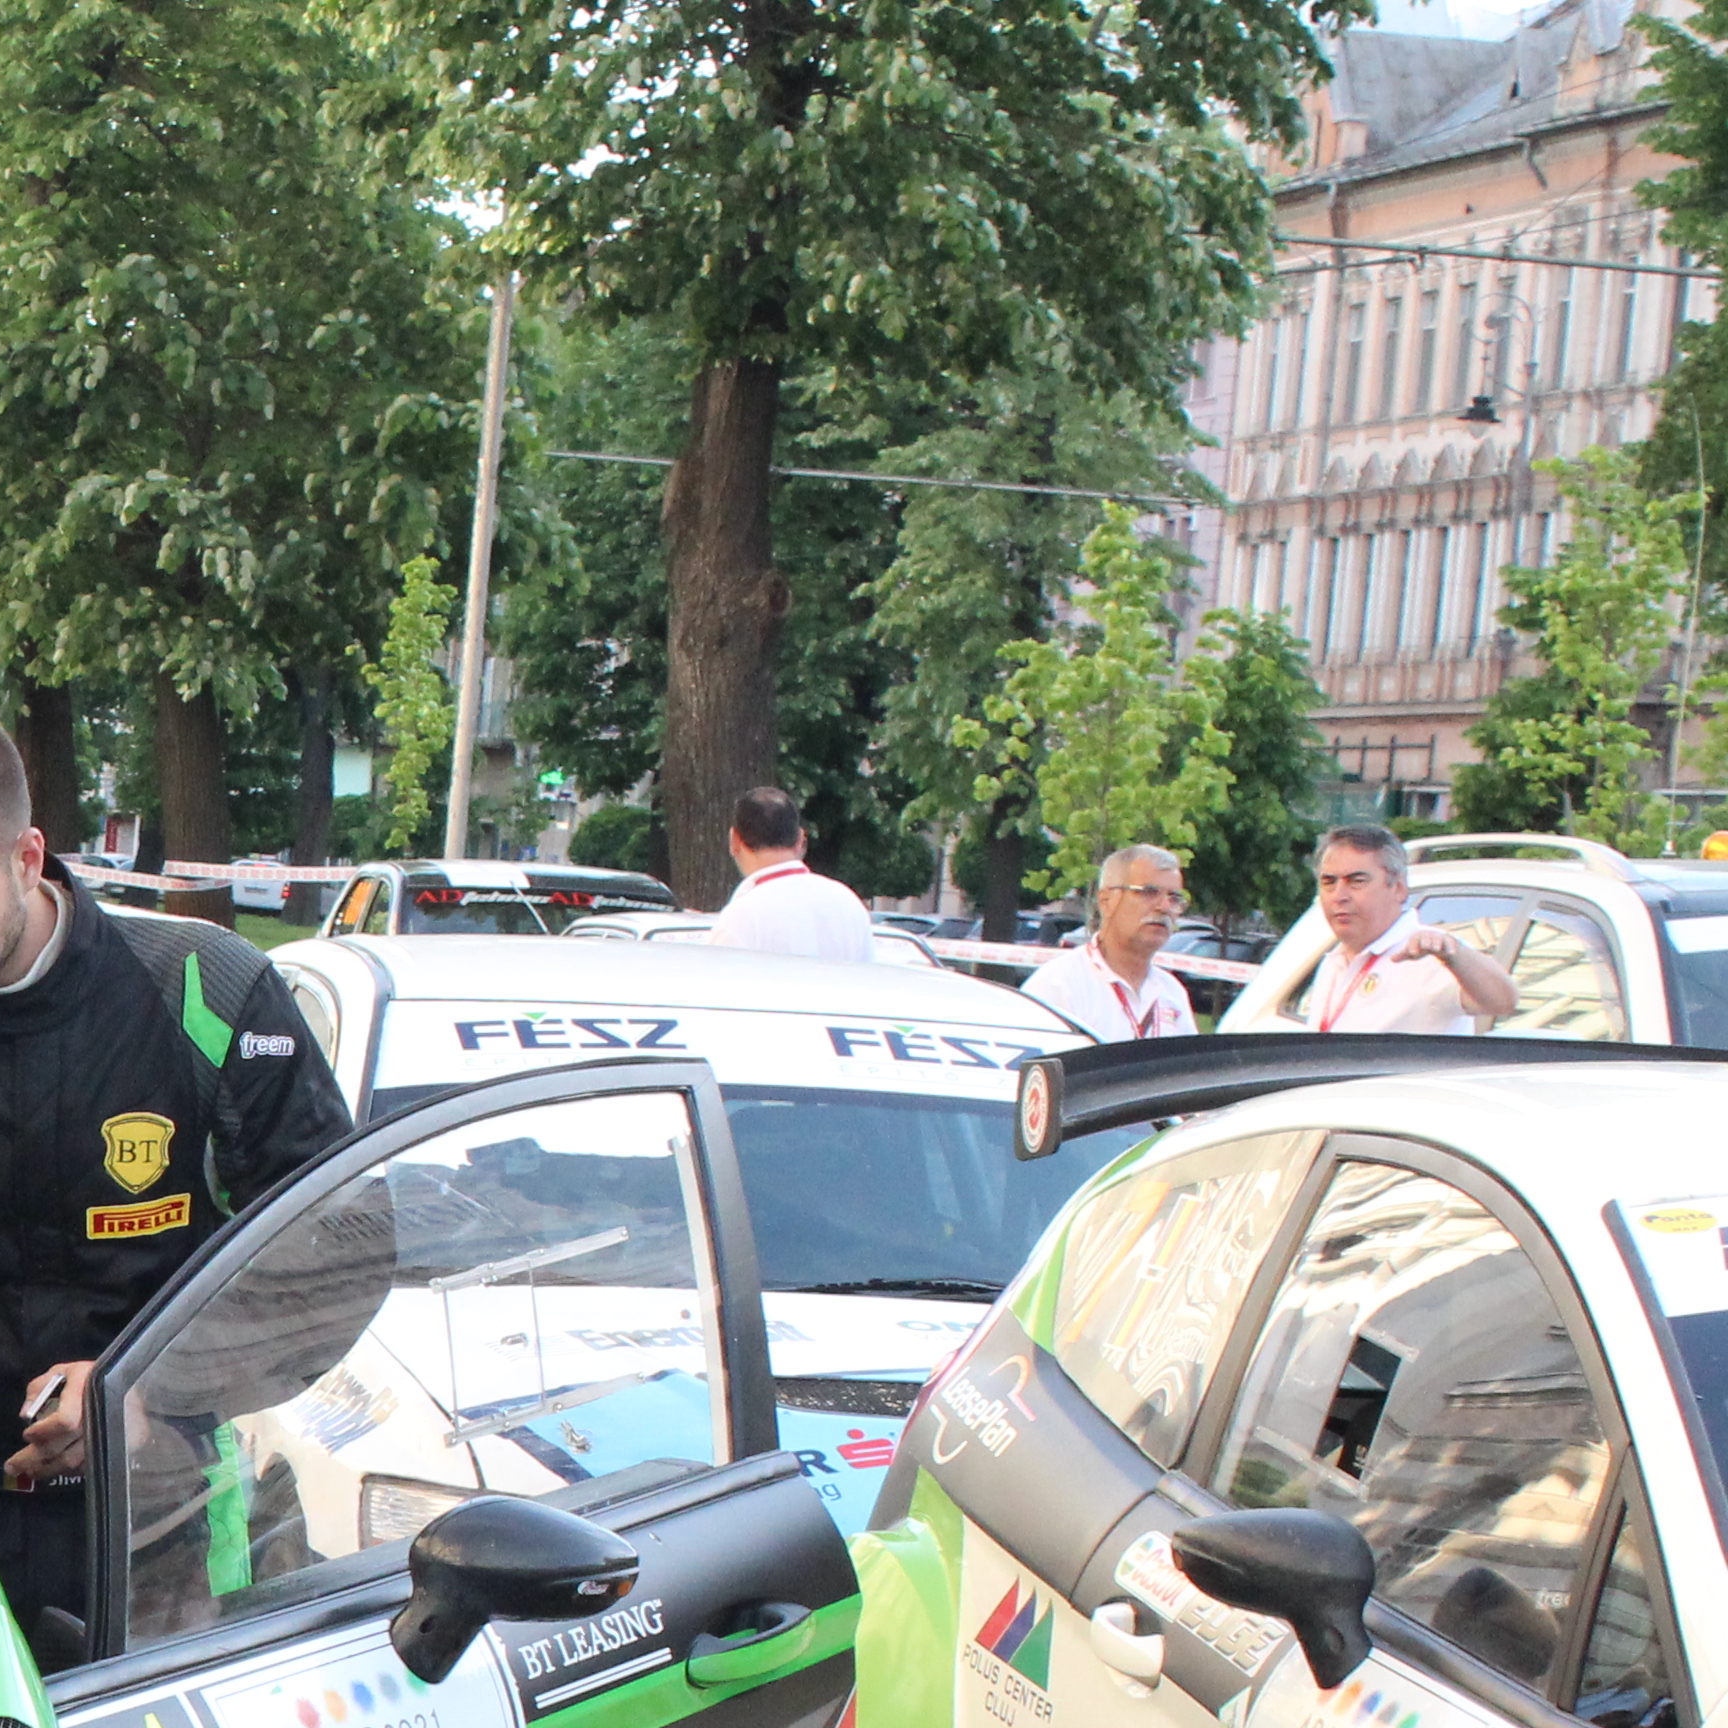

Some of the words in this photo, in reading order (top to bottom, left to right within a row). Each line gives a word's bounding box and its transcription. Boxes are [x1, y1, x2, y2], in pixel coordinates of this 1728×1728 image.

[241, 1031, 294, 1058] freem
[114, 1139, 157, 1164] BT
[94, 1200, 183, 1233] PIRELLI
[941, 1366, 1019, 1458] LeasePlan
[517, 1638, 553, 1680] BT
[553, 1600, 663, 1665] LEASING
[961, 1643, 1001, 1685] POLUS
[1004, 1674, 1054, 1724] CENTER
[984, 1691, 1017, 1728] CLUJ
